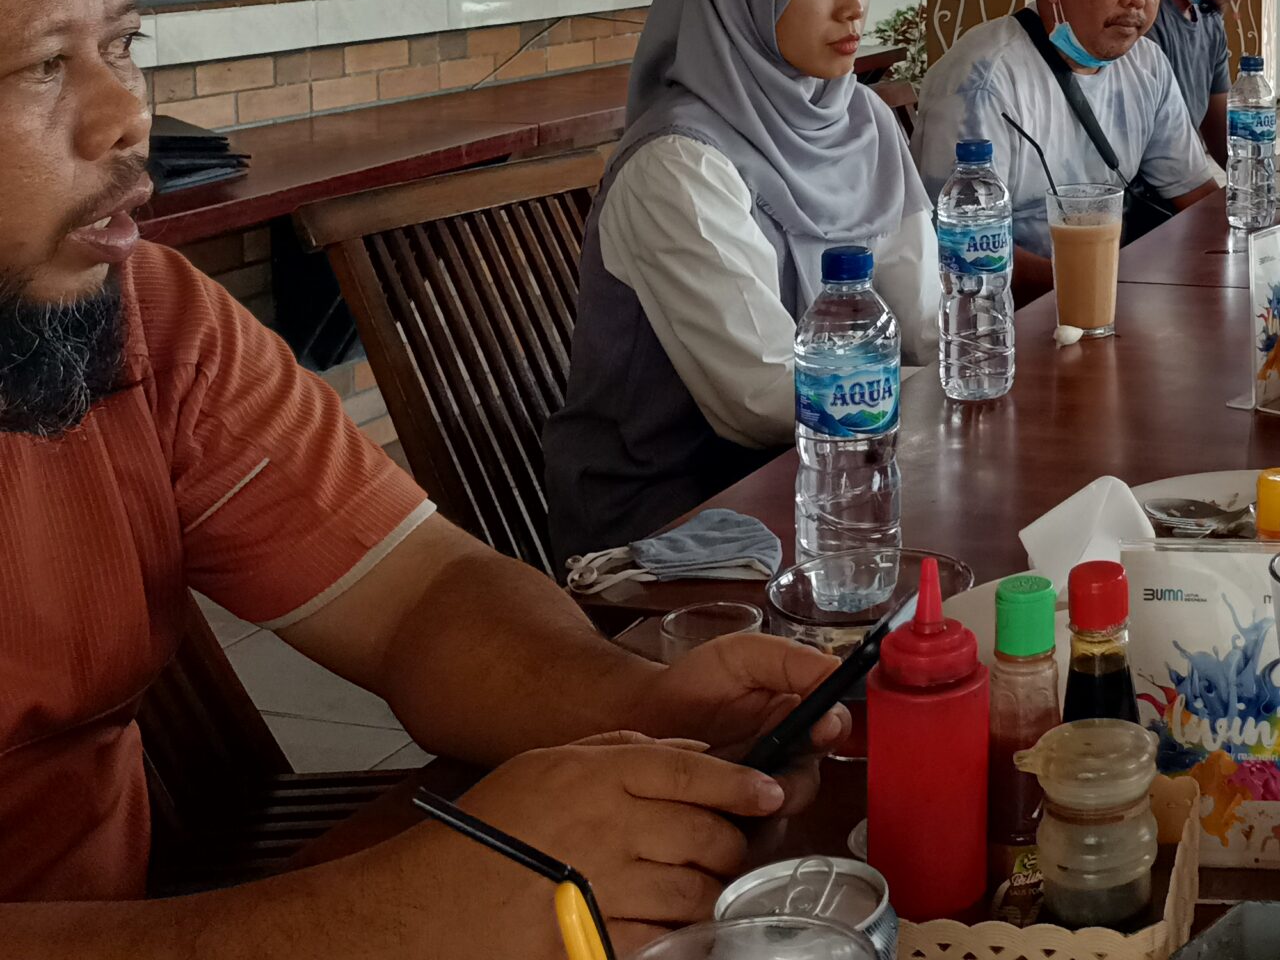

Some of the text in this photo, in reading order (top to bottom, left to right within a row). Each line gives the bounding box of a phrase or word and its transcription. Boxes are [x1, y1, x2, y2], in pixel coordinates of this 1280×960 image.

[966, 231, 1008, 254] AQUA
[830, 377, 893, 408] AQUA
[1143, 588, 1184, 601] BUMN
